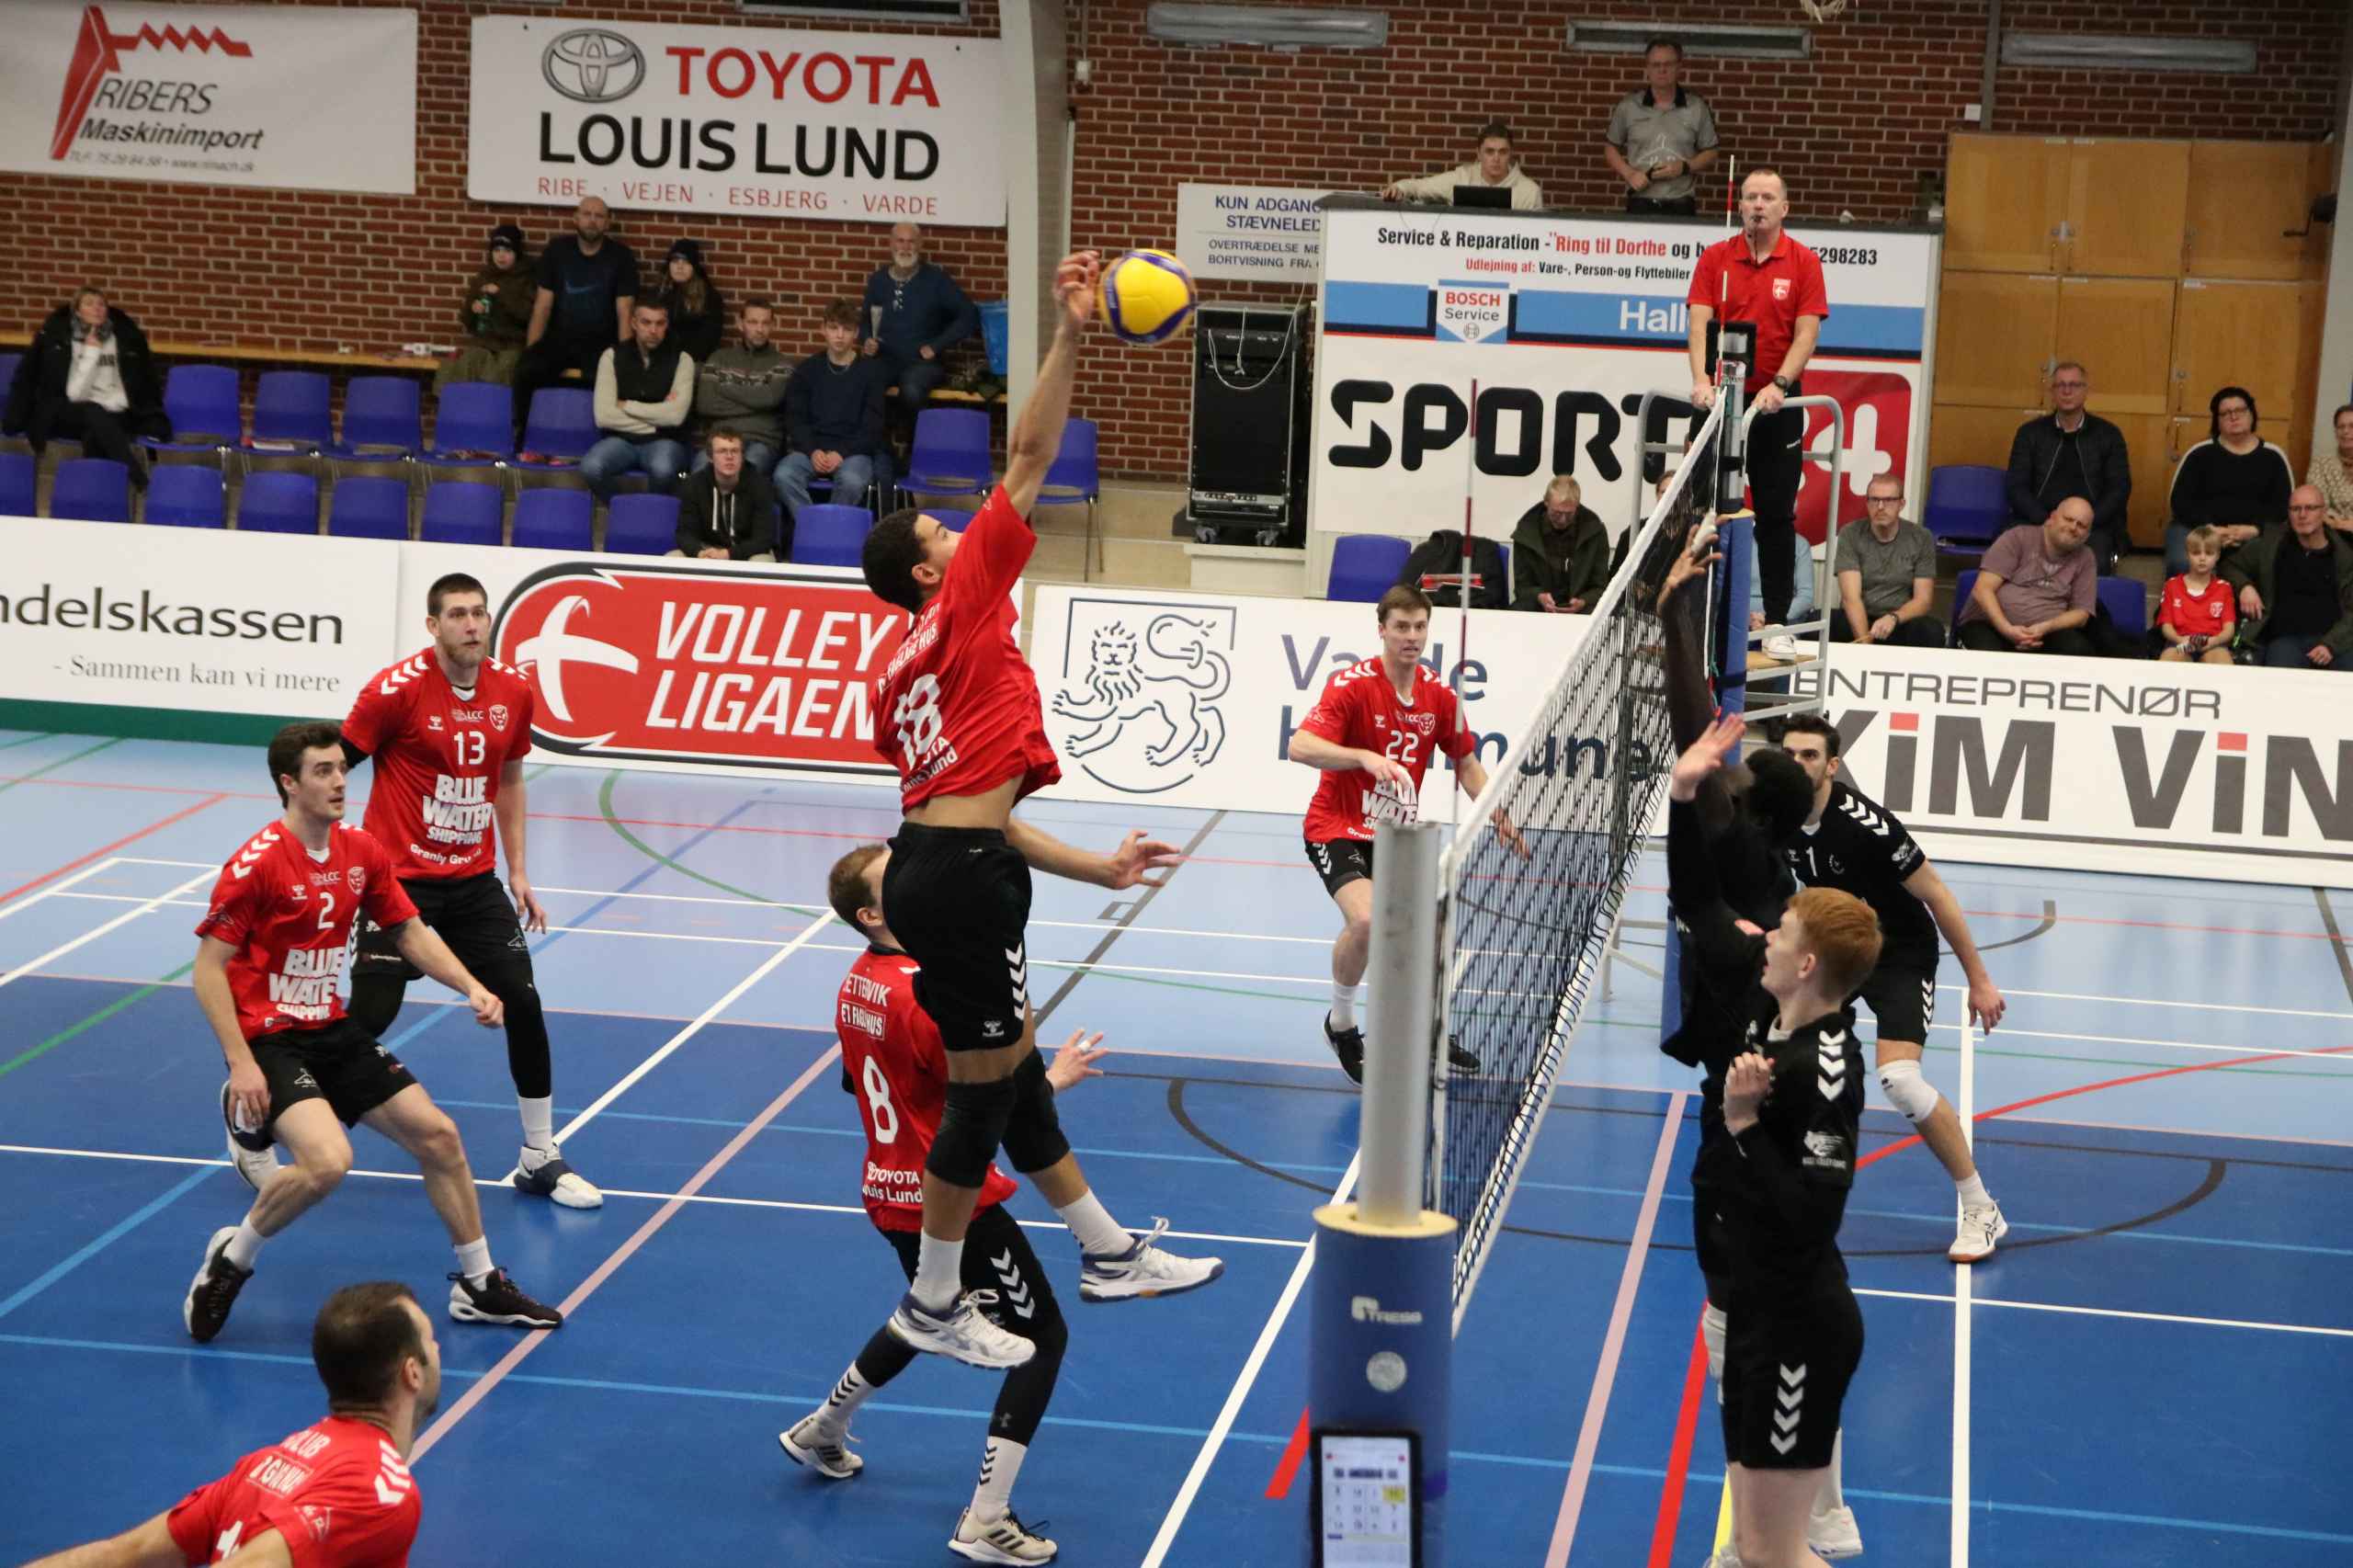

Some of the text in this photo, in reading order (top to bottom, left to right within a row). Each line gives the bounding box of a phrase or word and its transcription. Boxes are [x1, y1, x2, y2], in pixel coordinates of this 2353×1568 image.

[665, 45, 940, 108] TOYOTA
[95, 77, 219, 115] RIBERS
[80, 118, 265, 152] Maskinimport
[540, 111, 939, 181] LOUIS LUND
[538, 176, 938, 216] RIBE VEJEN ESBJERG VARDE
[1215, 196, 1248, 210] KUN
[1209, 239, 1299, 254] OVERTRÆDELSE
[1378, 227, 1435, 246] Service
[1439, 230, 1450, 247] &
[1456, 231, 1540, 251] Reparation
[1596, 237, 1610, 255] til
[1616, 238, 1666, 256] Dorthe
[1671, 243, 1690, 259] og
[1208, 254, 1284, 267] BORTVISNING
[1465, 257, 1518, 274] Udlejning
[1634, 266, 1691, 280] Flyttebiler
[1444, 307, 1500, 322] Service
[1445, 291, 1501, 307] BOSCH
[1620, 300, 1690, 334] Hall
[655, 600, 898, 672] VOLLEY
[70, 654, 181, 683] Sammen
[189, 662, 235, 687] kan
[244, 665, 266, 688] vi
[275, 673, 341, 693] mere
[646, 669, 875, 741] LIGAEN
[1793, 668, 2222, 720] ENTREPRENØR
[453, 731, 486, 766] 13
[1384, 730, 1419, 764] 22
[435, 773, 488, 806] BLUE
[422, 794, 494, 832] WATER
[1805, 846, 1818, 877] 1
[317, 892, 335, 930] 2
[283, 946, 346, 979] BLUE
[862, 1054, 899, 1144] 8
[885, 1187, 924, 1203] Lund
